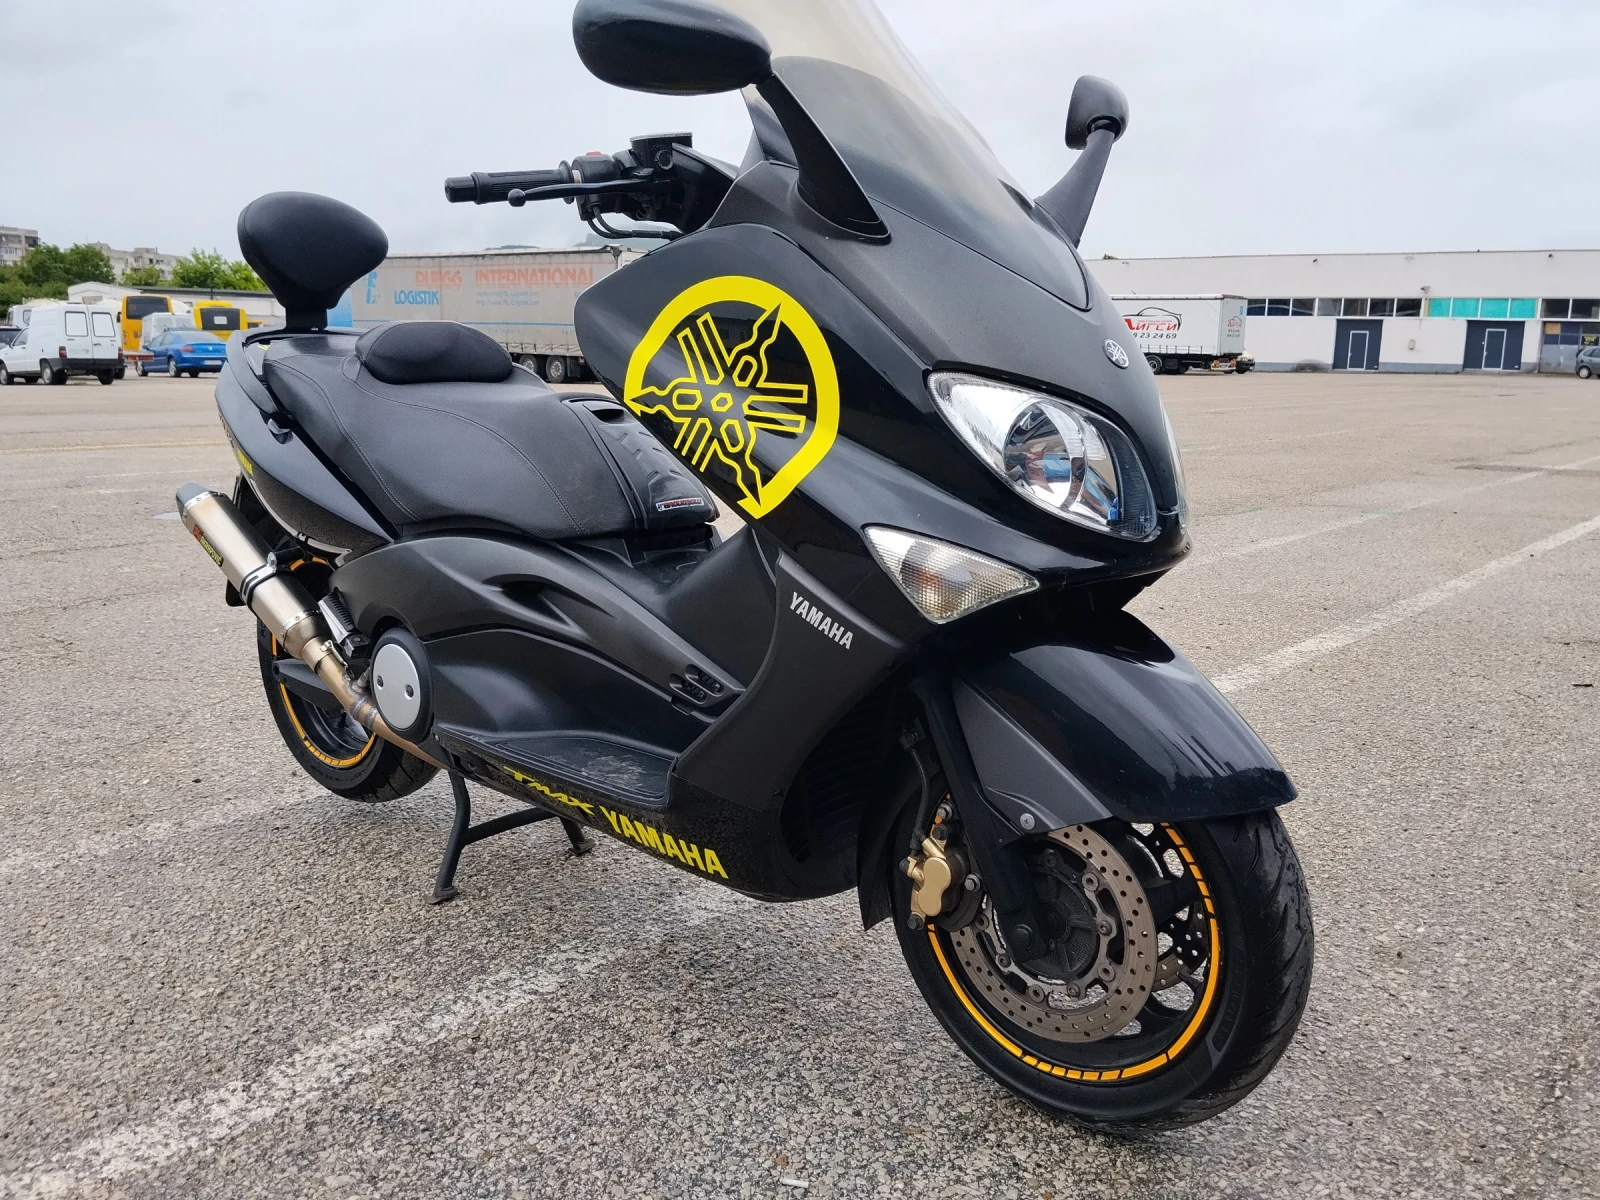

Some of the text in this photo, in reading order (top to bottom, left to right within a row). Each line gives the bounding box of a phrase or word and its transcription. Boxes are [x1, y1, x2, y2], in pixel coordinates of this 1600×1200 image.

[394, 289, 440, 305] LOGISTIK
[790, 591, 854, 650] YAMAHA
[599, 805, 730, 880] YAMAHA
